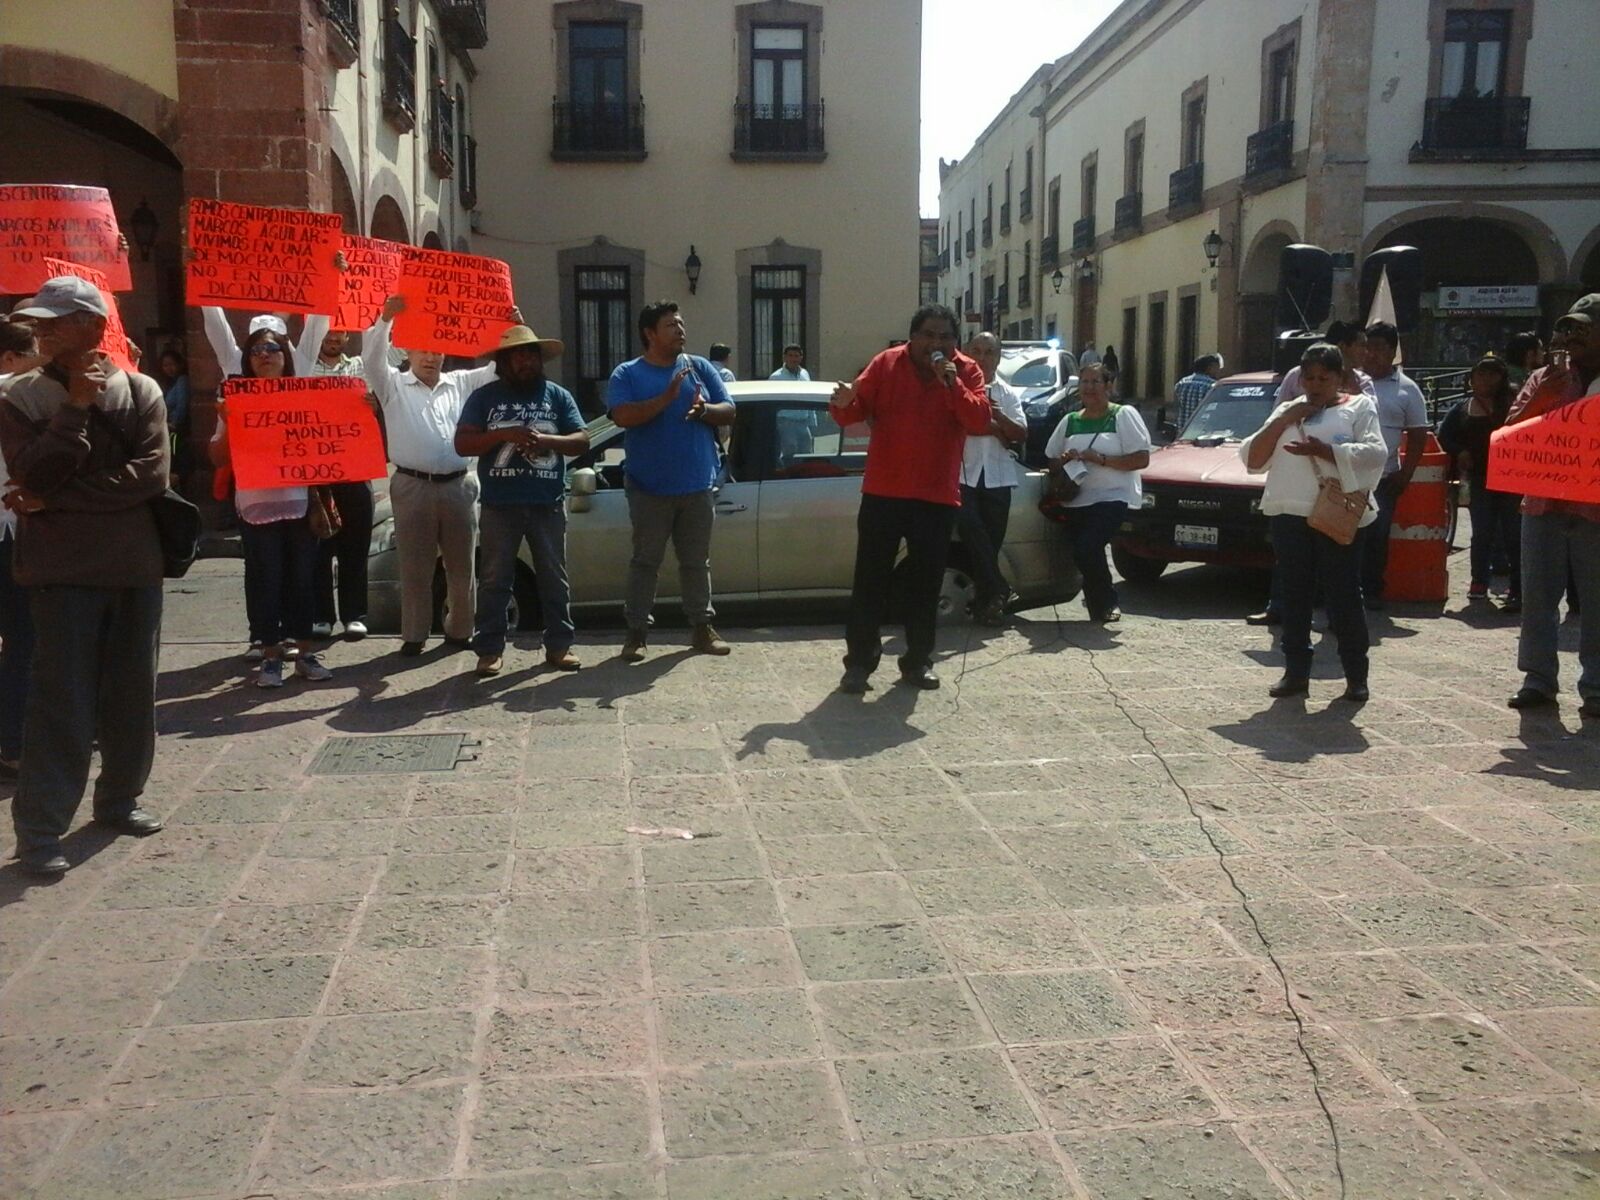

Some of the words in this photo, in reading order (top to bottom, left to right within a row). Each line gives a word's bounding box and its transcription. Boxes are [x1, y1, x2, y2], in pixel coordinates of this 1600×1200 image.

[190, 199, 228, 218] SOMOS
[230, 204, 279, 223] CENTRO
[0, 216, 42, 232] ARCOS
[194, 216, 249, 236] MARCOS
[33, 234, 53, 248] DE
[193, 232, 249, 251] VIVIMOS
[253, 238, 274, 253] EN
[282, 242, 313, 257] UNA
[11, 251, 33, 264] TU
[193, 248, 318, 271] DEMOCRACIA
[345, 250, 399, 267] ZEQUIEL
[401, 248, 436, 264] SOMOS
[192, 265, 218, 278] NO
[233, 269, 261, 283] EN
[275, 273, 314, 287] UNA
[341, 264, 398, 280] MONTES
[403, 263, 475, 285] EZEQUIEL
[208, 281, 306, 303] DICTADURA
[345, 278, 363, 290] NO
[372, 279, 392, 294] SE
[427, 281, 449, 296] HA
[457, 284, 509, 302] PERDIDO
[424, 296, 438, 312] 5
[448, 300, 513, 319] NEGOCIOS
[436, 314, 461, 329] POR
[467, 317, 487, 331] LA
[433, 329, 480, 345] OBRA
[224, 380, 261, 396] SOMOS
[263, 379, 306, 394] CENTRO
[244, 410, 328, 428] EZEQUIEL
[487, 407, 506, 422] Los
[511, 407, 558, 426] Angeles
[285, 423, 361, 441] MONTES
[1516, 433, 1535, 445] UN
[282, 442, 307, 458] ES
[318, 440, 346, 456] DE
[1497, 447, 1581, 468] INFUNDADA
[280, 463, 345, 481] TODOS
[1178, 499, 1220, 509] NISSAN
